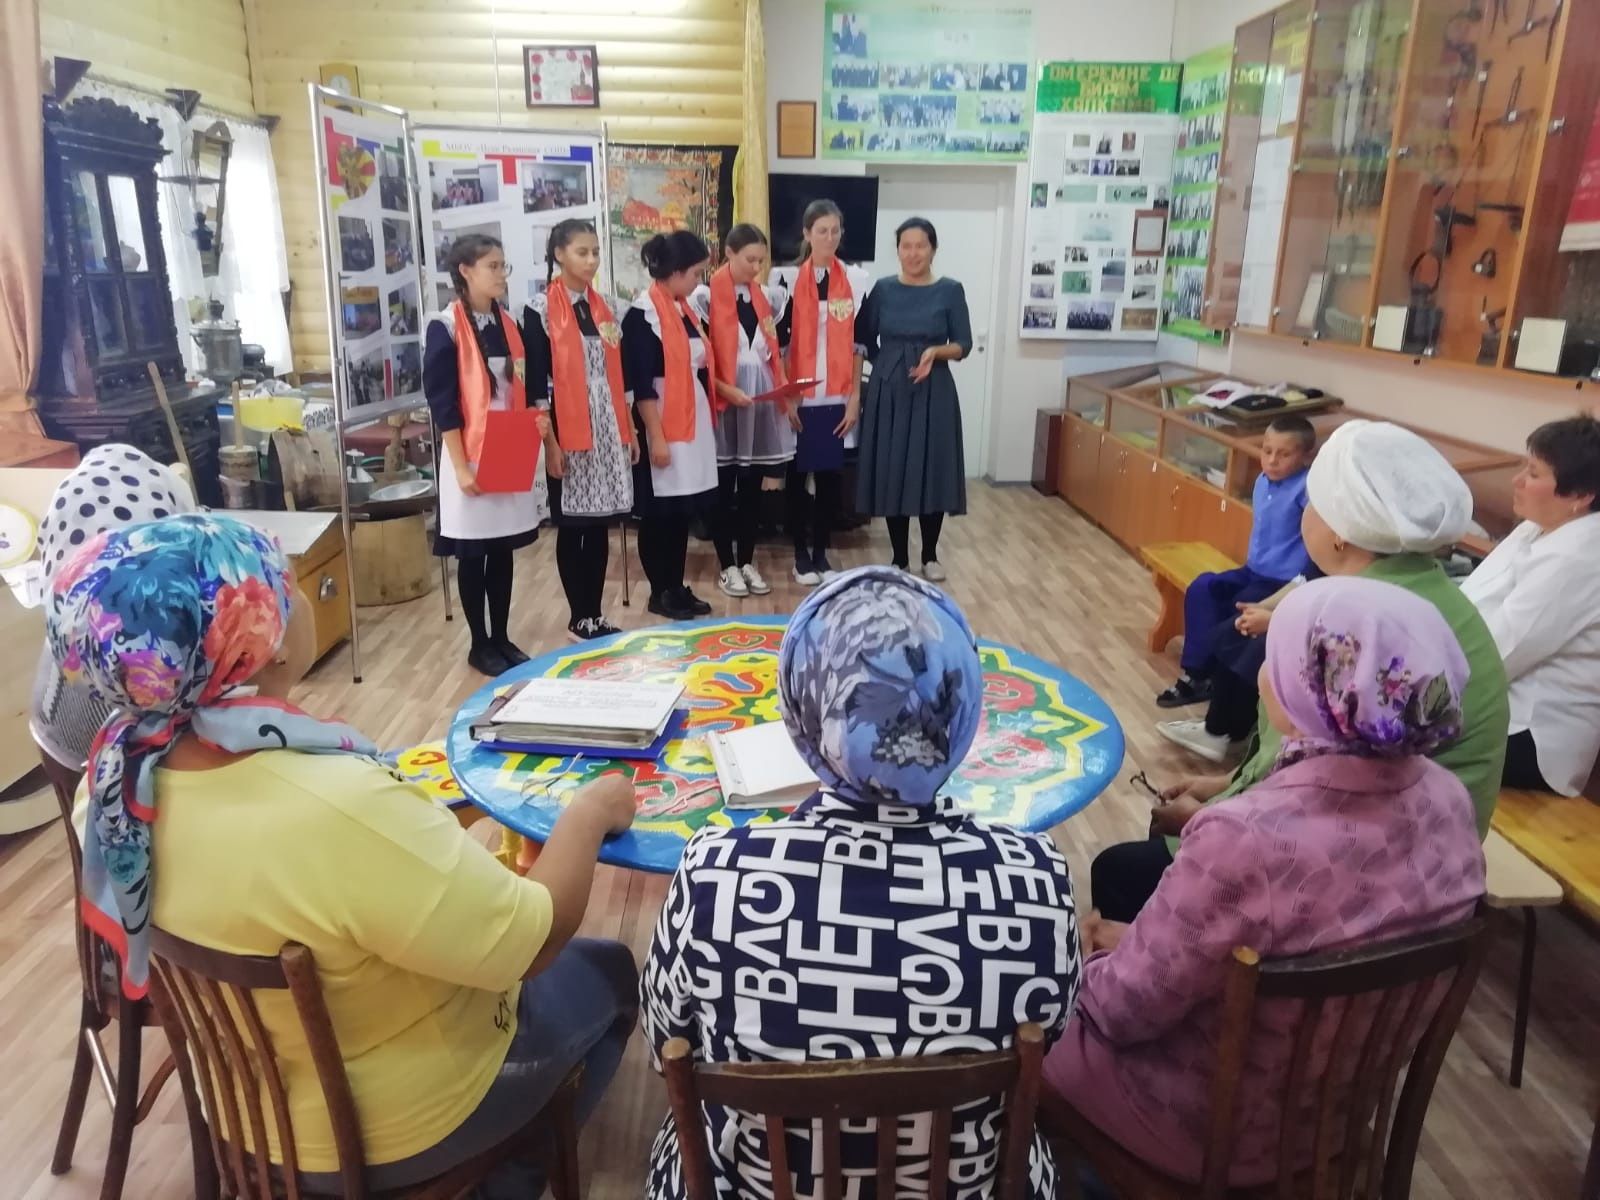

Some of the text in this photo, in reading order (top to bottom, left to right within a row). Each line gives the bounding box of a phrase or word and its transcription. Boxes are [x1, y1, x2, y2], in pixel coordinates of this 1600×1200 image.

[947, 866, 996, 910] H
[967, 914, 1031, 951] B
[734, 966, 798, 1004] B
[798, 966, 899, 1034] H
[908, 1003, 972, 1035] B
